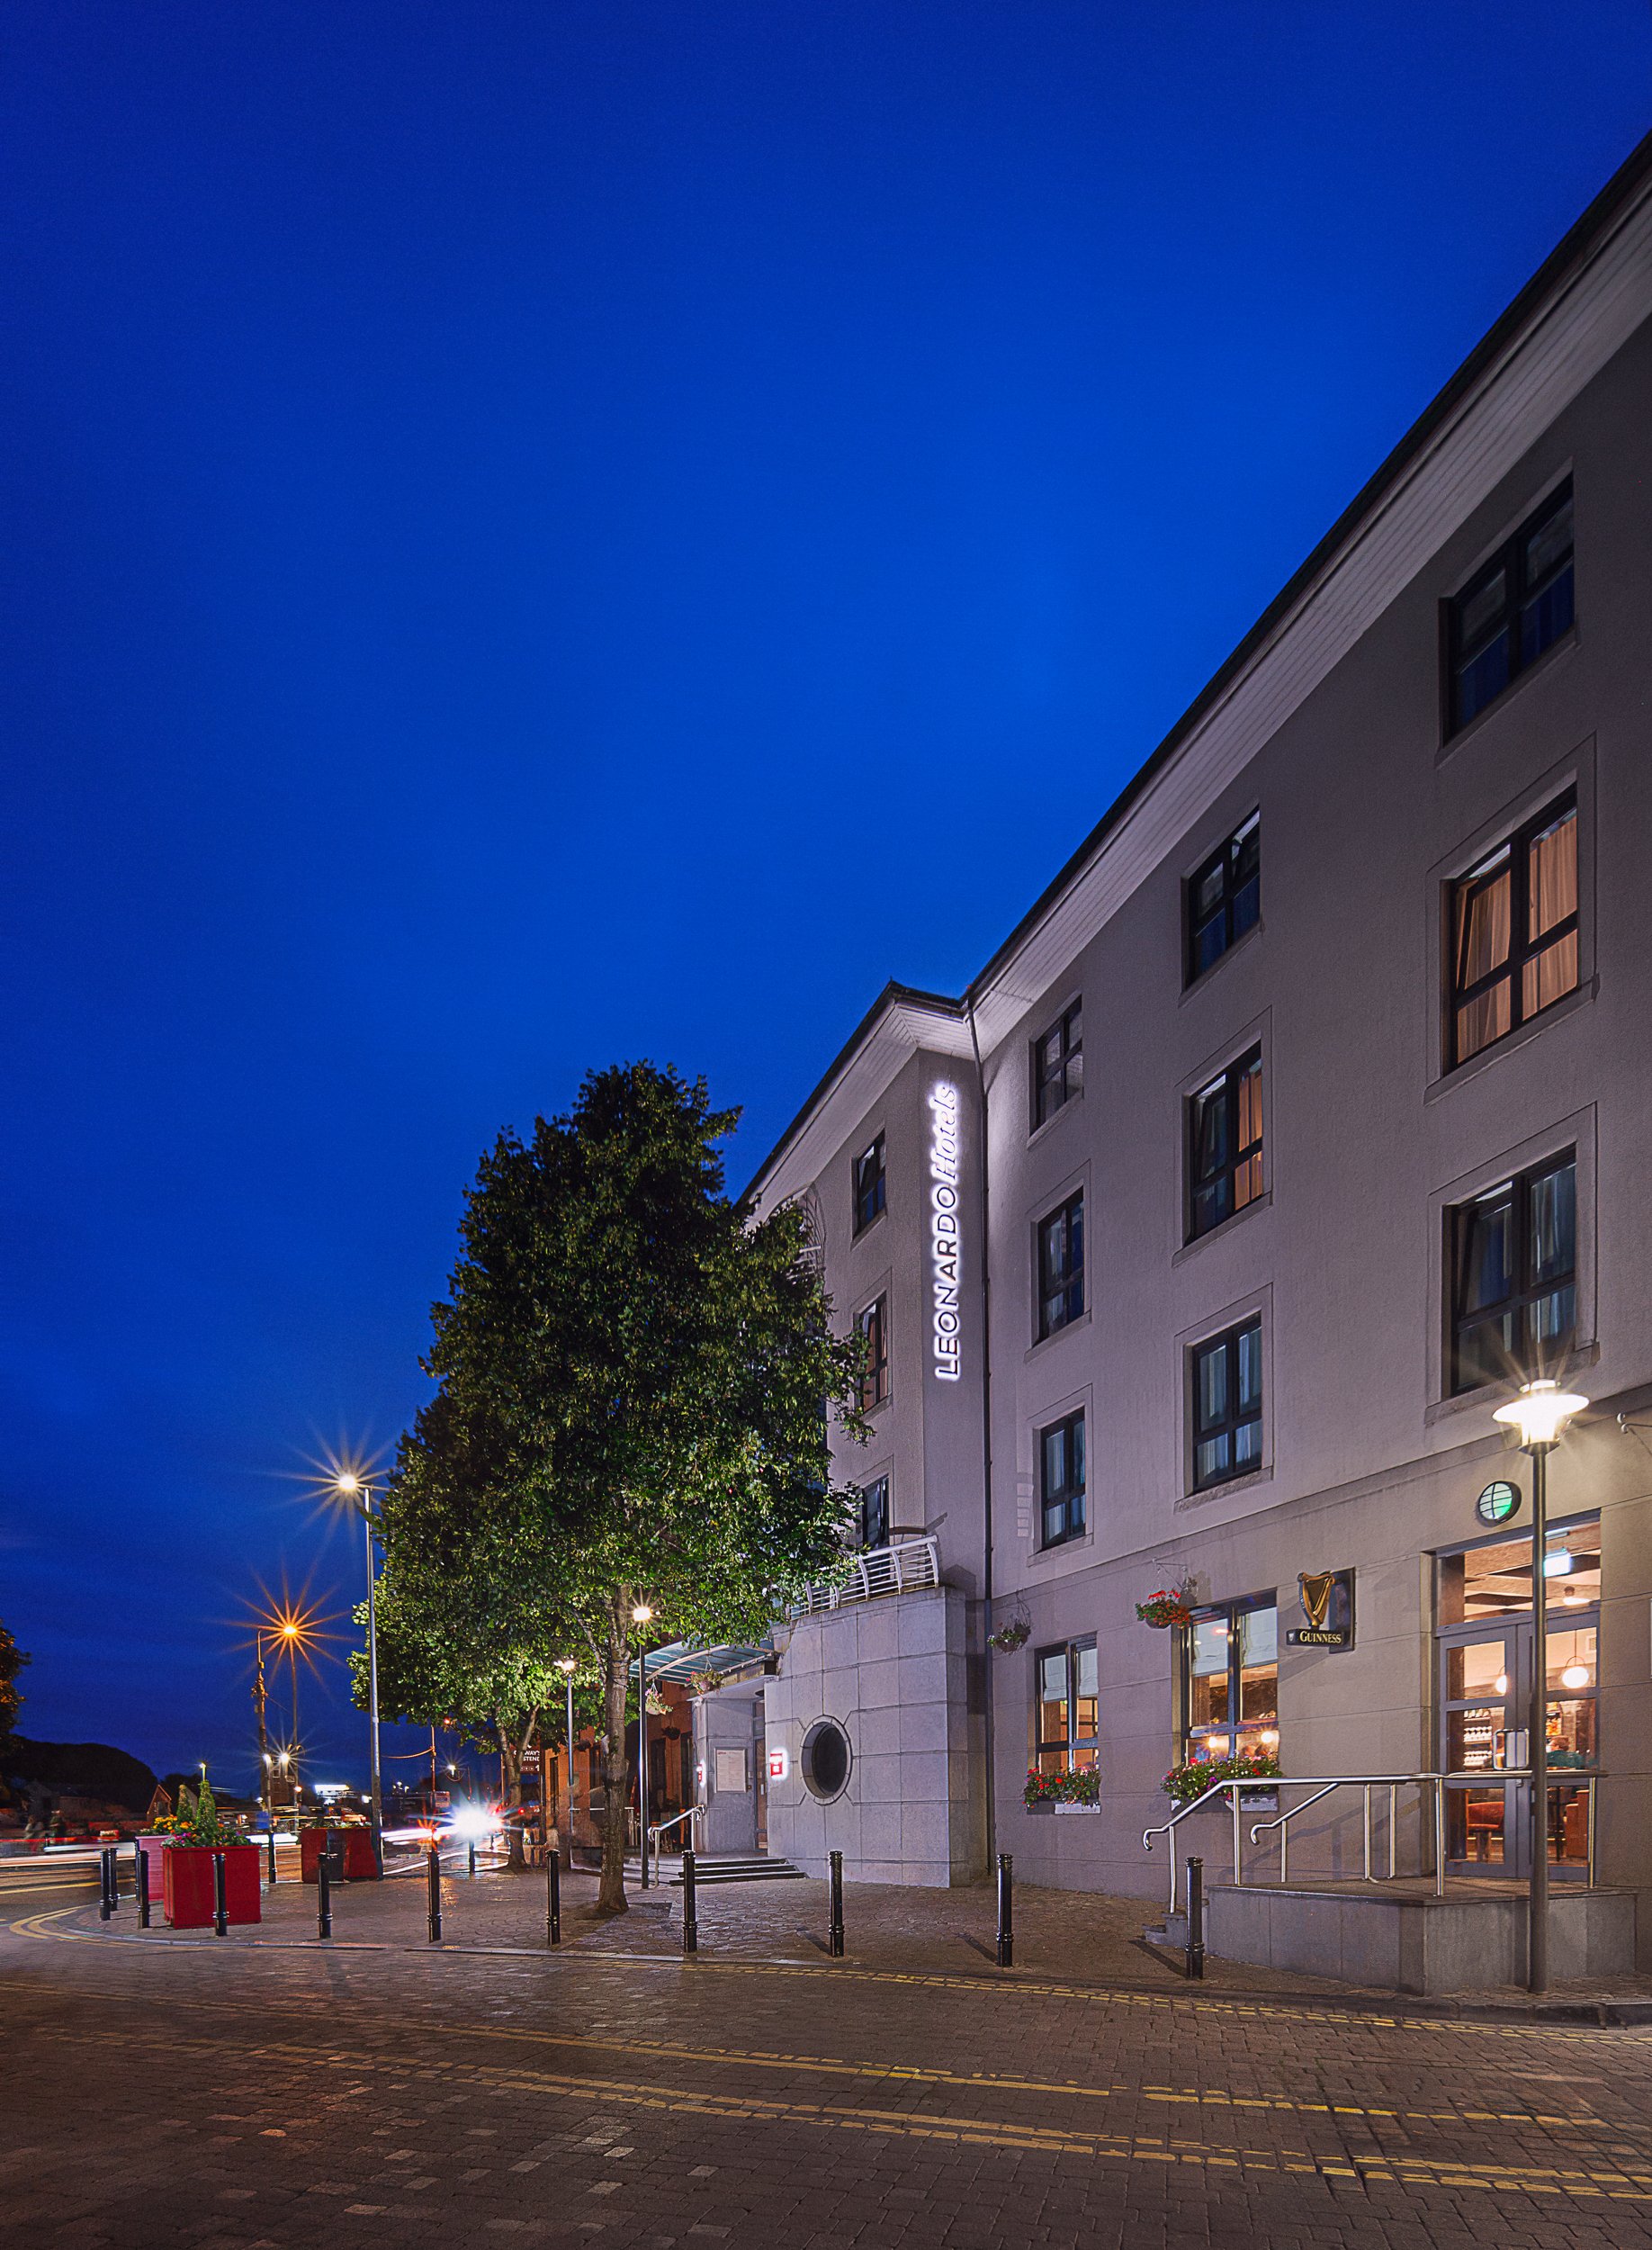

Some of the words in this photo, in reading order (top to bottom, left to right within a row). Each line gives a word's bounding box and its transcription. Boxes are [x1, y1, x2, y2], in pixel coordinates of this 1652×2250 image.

[934, 1084, 956, 1181] Hotels
[936, 1184, 959, 1377] LEONARDO
[1299, 1630, 1342, 1643] GUINNESS
